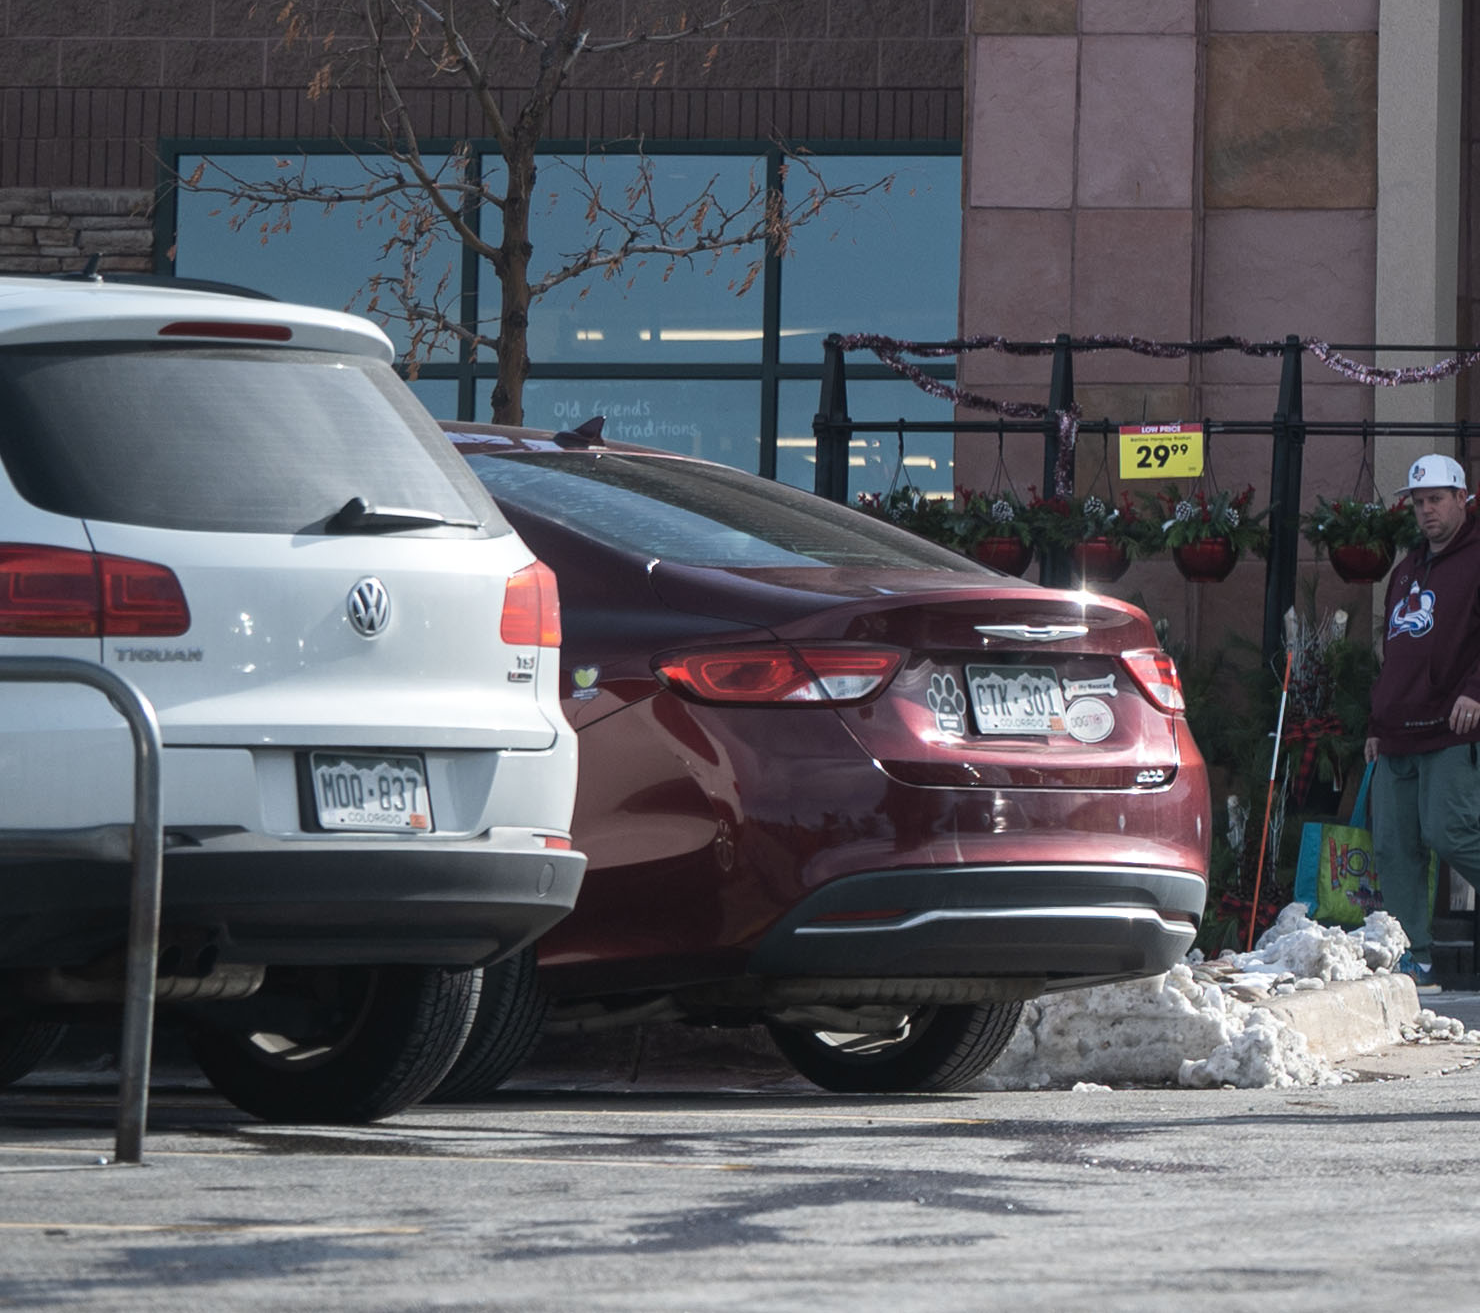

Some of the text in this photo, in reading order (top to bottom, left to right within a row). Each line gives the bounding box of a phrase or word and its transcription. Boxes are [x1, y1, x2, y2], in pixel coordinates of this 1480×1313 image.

[553, 400, 582, 418] Old
[1160, 425, 1181, 433] PRICE
[114, 647, 204, 663] TIGUAN
[347, 811, 403, 825] COLORADO
